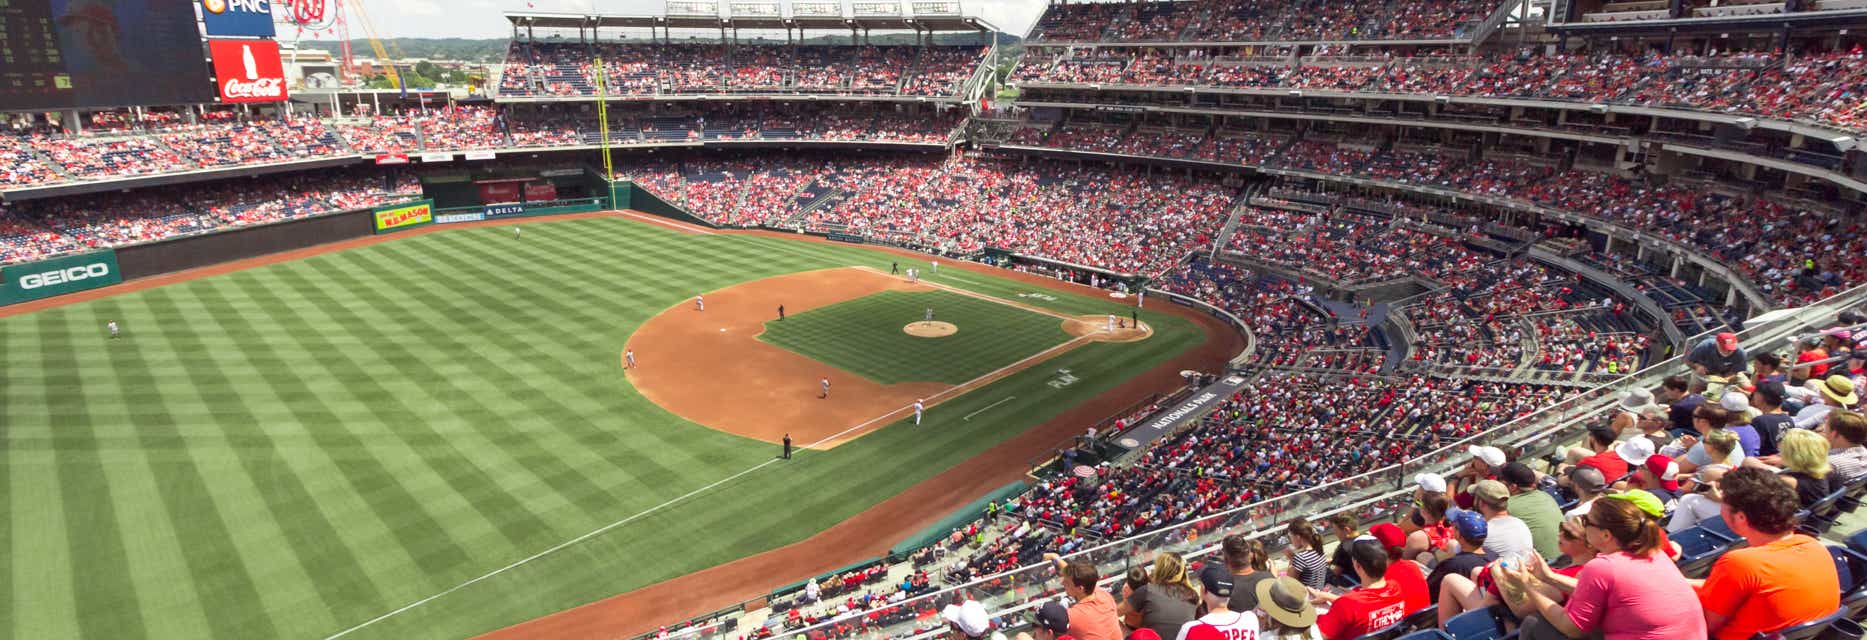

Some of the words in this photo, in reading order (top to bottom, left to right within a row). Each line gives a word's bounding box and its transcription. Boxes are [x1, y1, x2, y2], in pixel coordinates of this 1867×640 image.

[229, 0, 270, 13] PNC
[495, 206, 524, 215] DELTA
[19, 262, 109, 290] GEICO
[1151, 402, 1198, 430] NATIONALS
[1193, 391, 1217, 406] PARK
